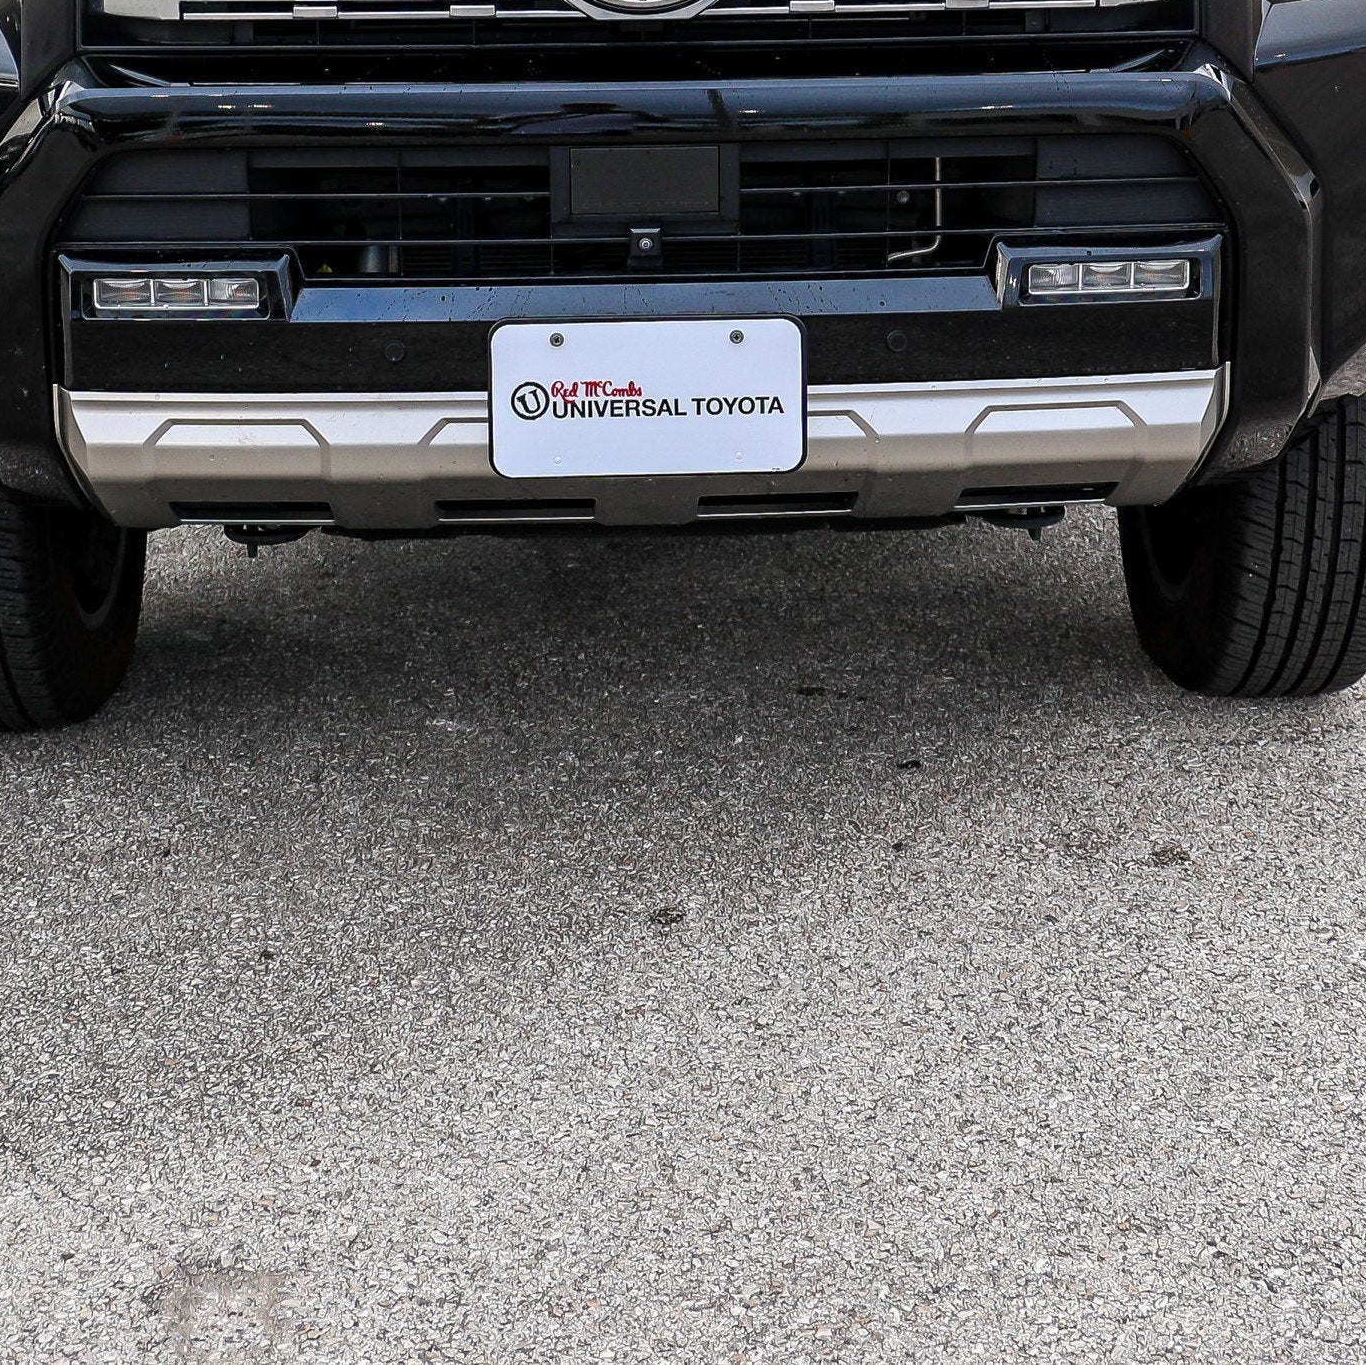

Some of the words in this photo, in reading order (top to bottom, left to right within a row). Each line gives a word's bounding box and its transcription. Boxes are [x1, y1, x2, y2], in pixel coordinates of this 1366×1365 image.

[551, 381, 578, 402] Red
[581, 380, 643, 398] McCombs
[552, 398, 687, 419] UNIVERSAL
[691, 396, 784, 416] TOYOTA
